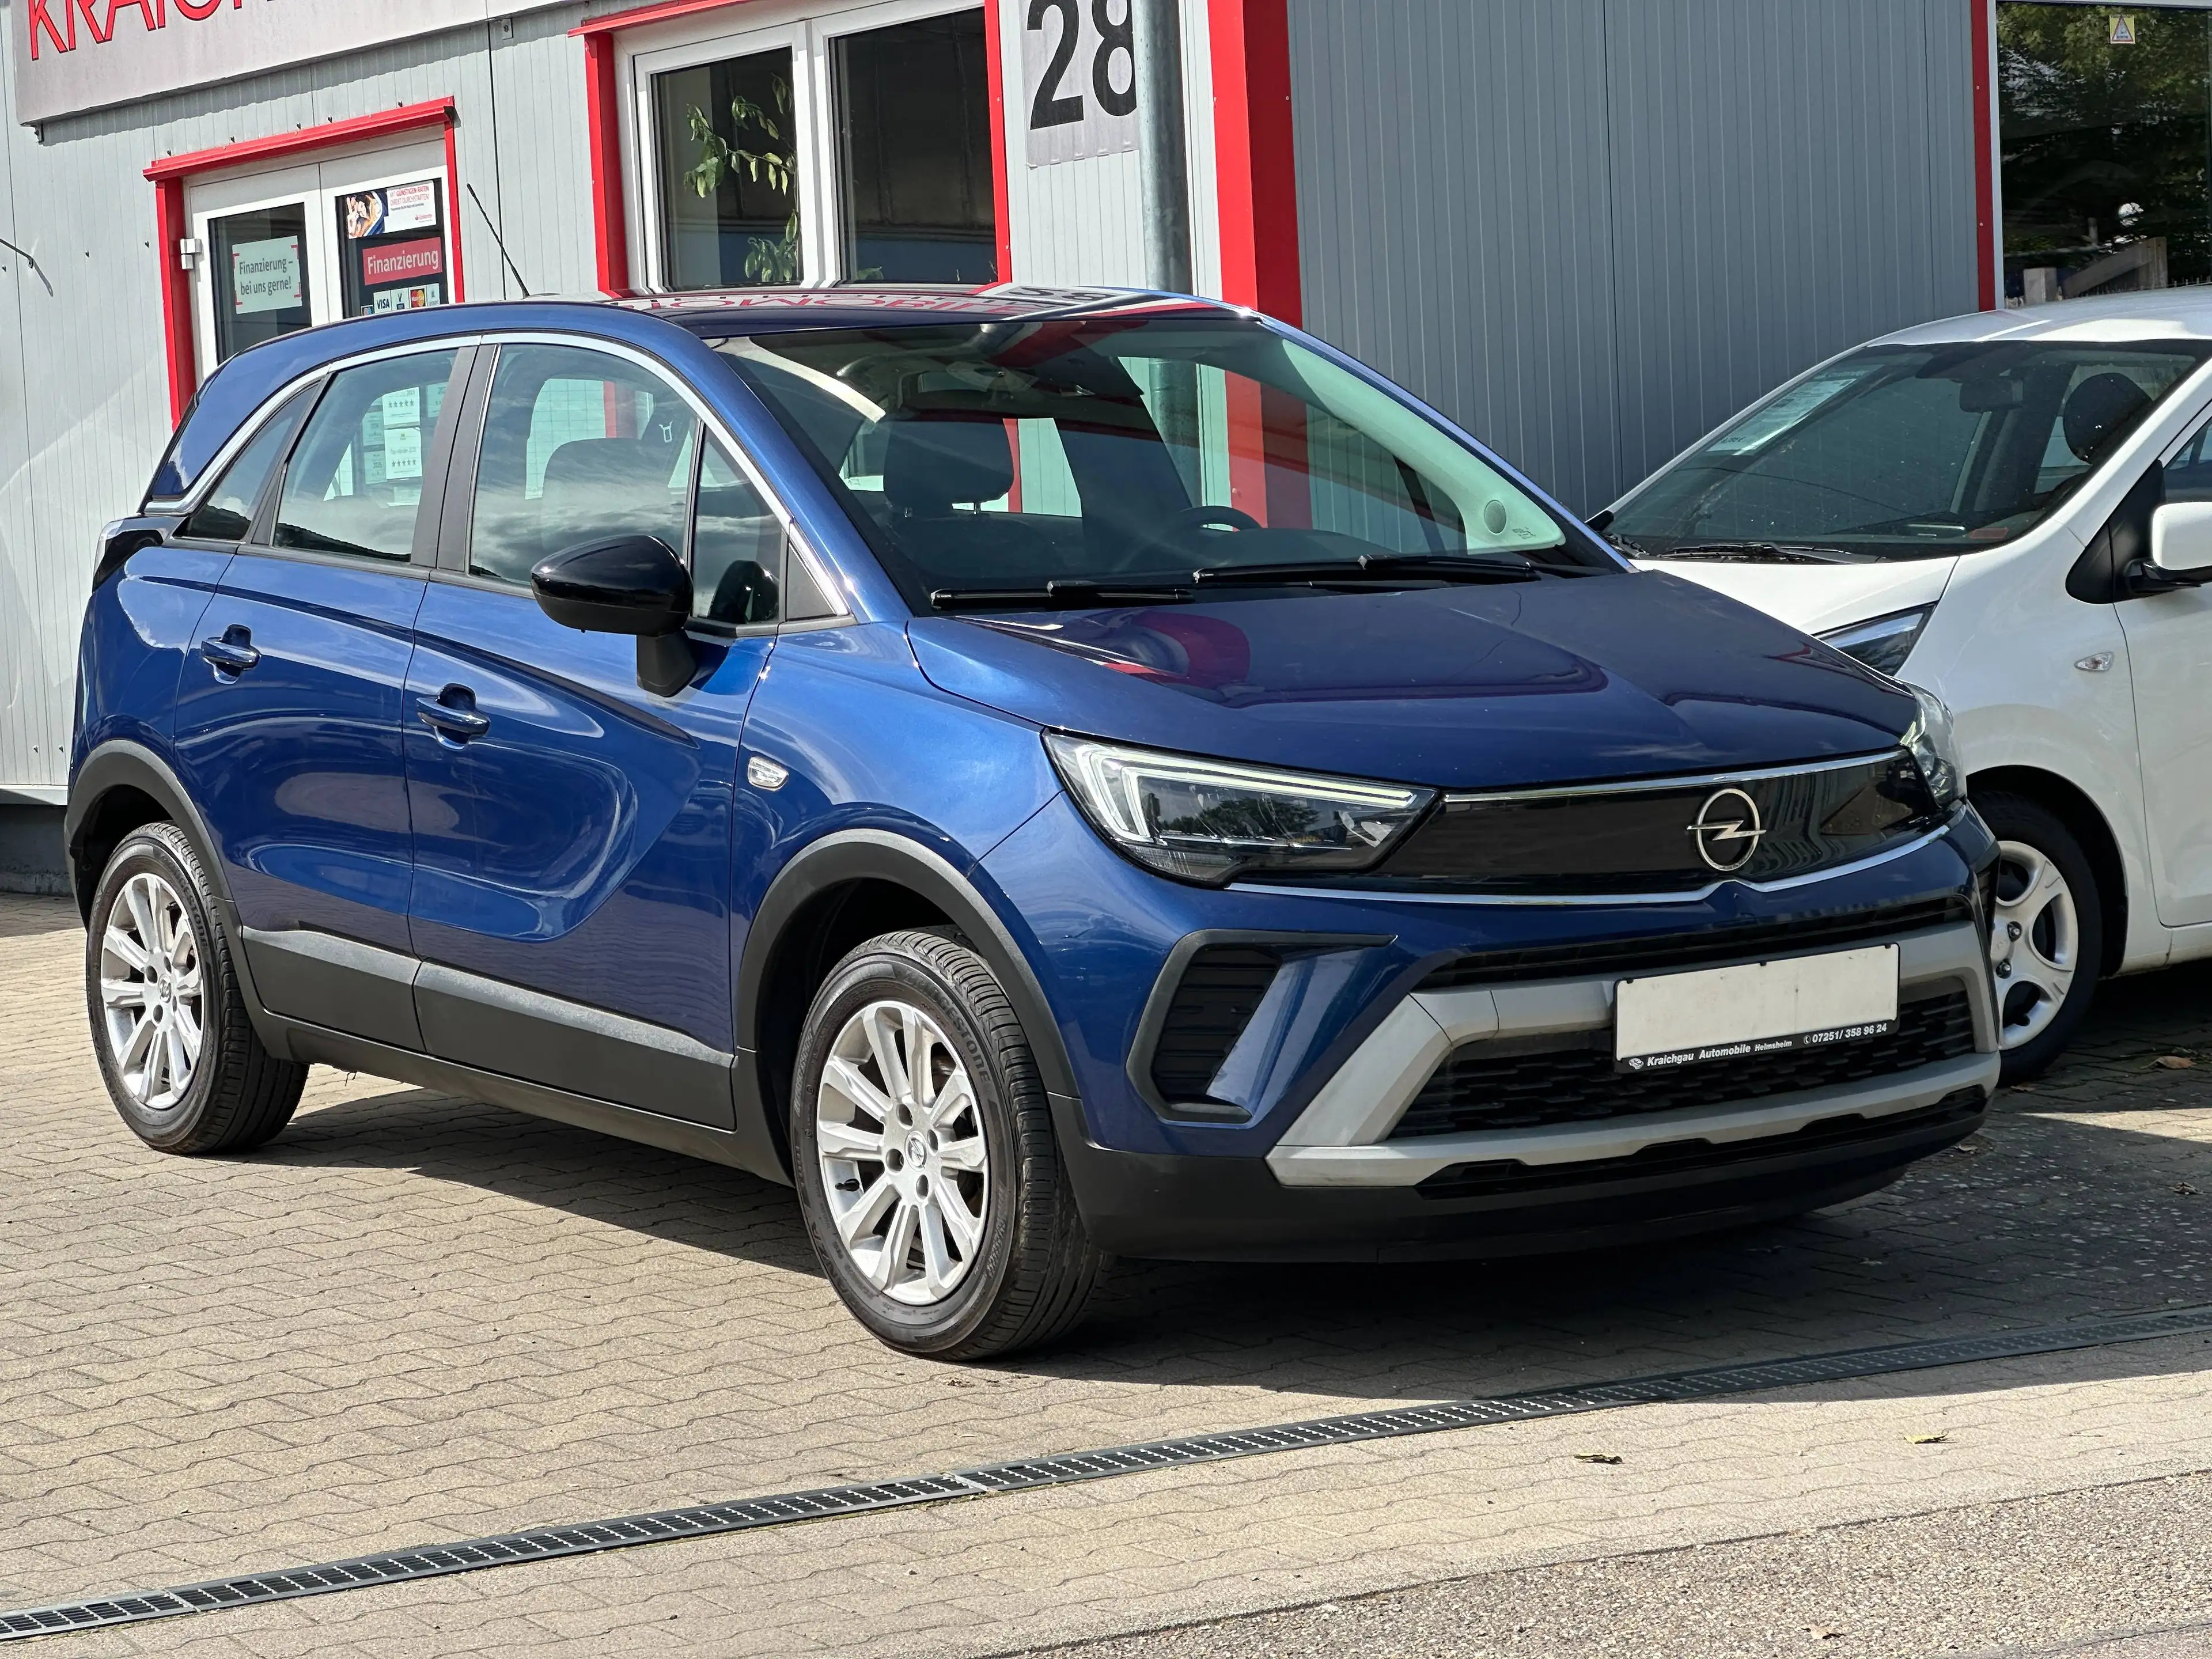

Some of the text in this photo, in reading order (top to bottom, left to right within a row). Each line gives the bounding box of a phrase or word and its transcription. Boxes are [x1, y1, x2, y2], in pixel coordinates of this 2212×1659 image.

[1027, 0, 1137, 131] 28
[239, 257, 287, 275] Finanzierung
[368, 250, 439, 275] Finanzierung
[240, 276, 291, 296] bei uns gerne!
[376, 298, 390, 309] VISA
[1647, 1022, 1887, 1067] Kraichgau Automobile Helmsheim 07251/ 358 96 24
